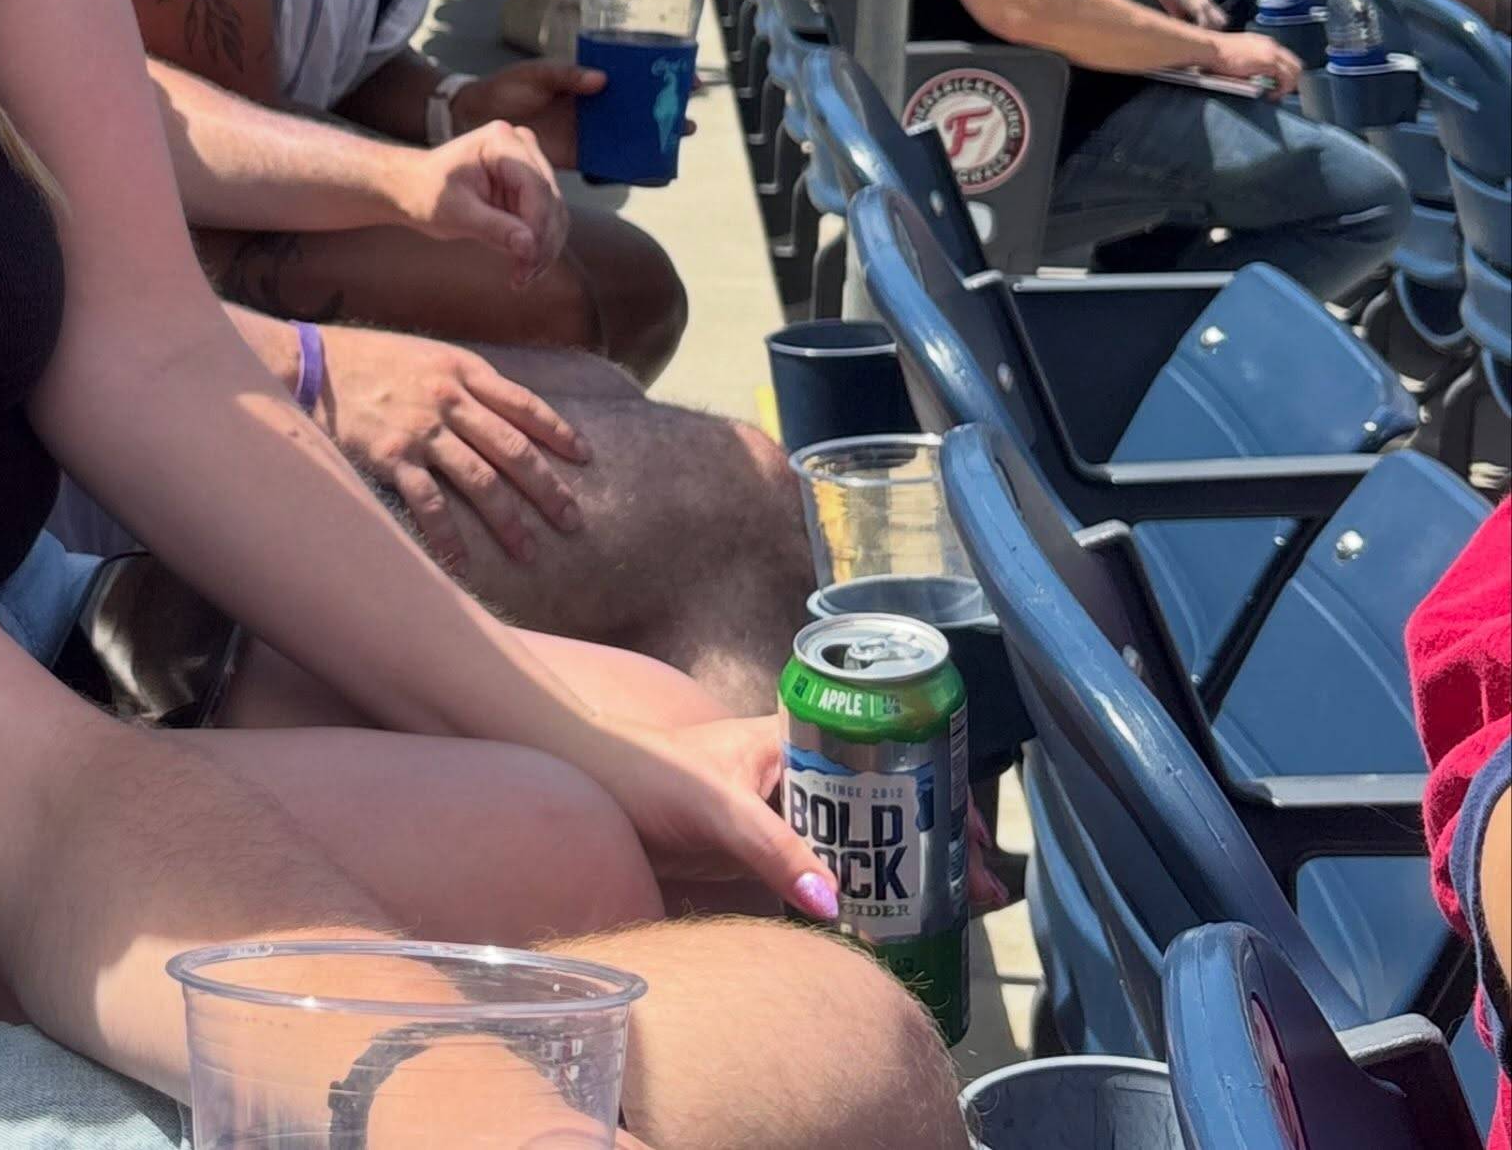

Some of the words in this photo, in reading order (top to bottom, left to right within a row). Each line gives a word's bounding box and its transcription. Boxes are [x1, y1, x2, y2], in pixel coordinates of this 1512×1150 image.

[945, 104, 994, 158] F
[817, 686, 864, 717] APPLE
[825, 781, 863, 798] SINCE
[872, 787, 904, 799] 2012
[789, 780, 904, 849] BOLD
[812, 844, 909, 901] OCK
[839, 900, 912, 918] CIDER
